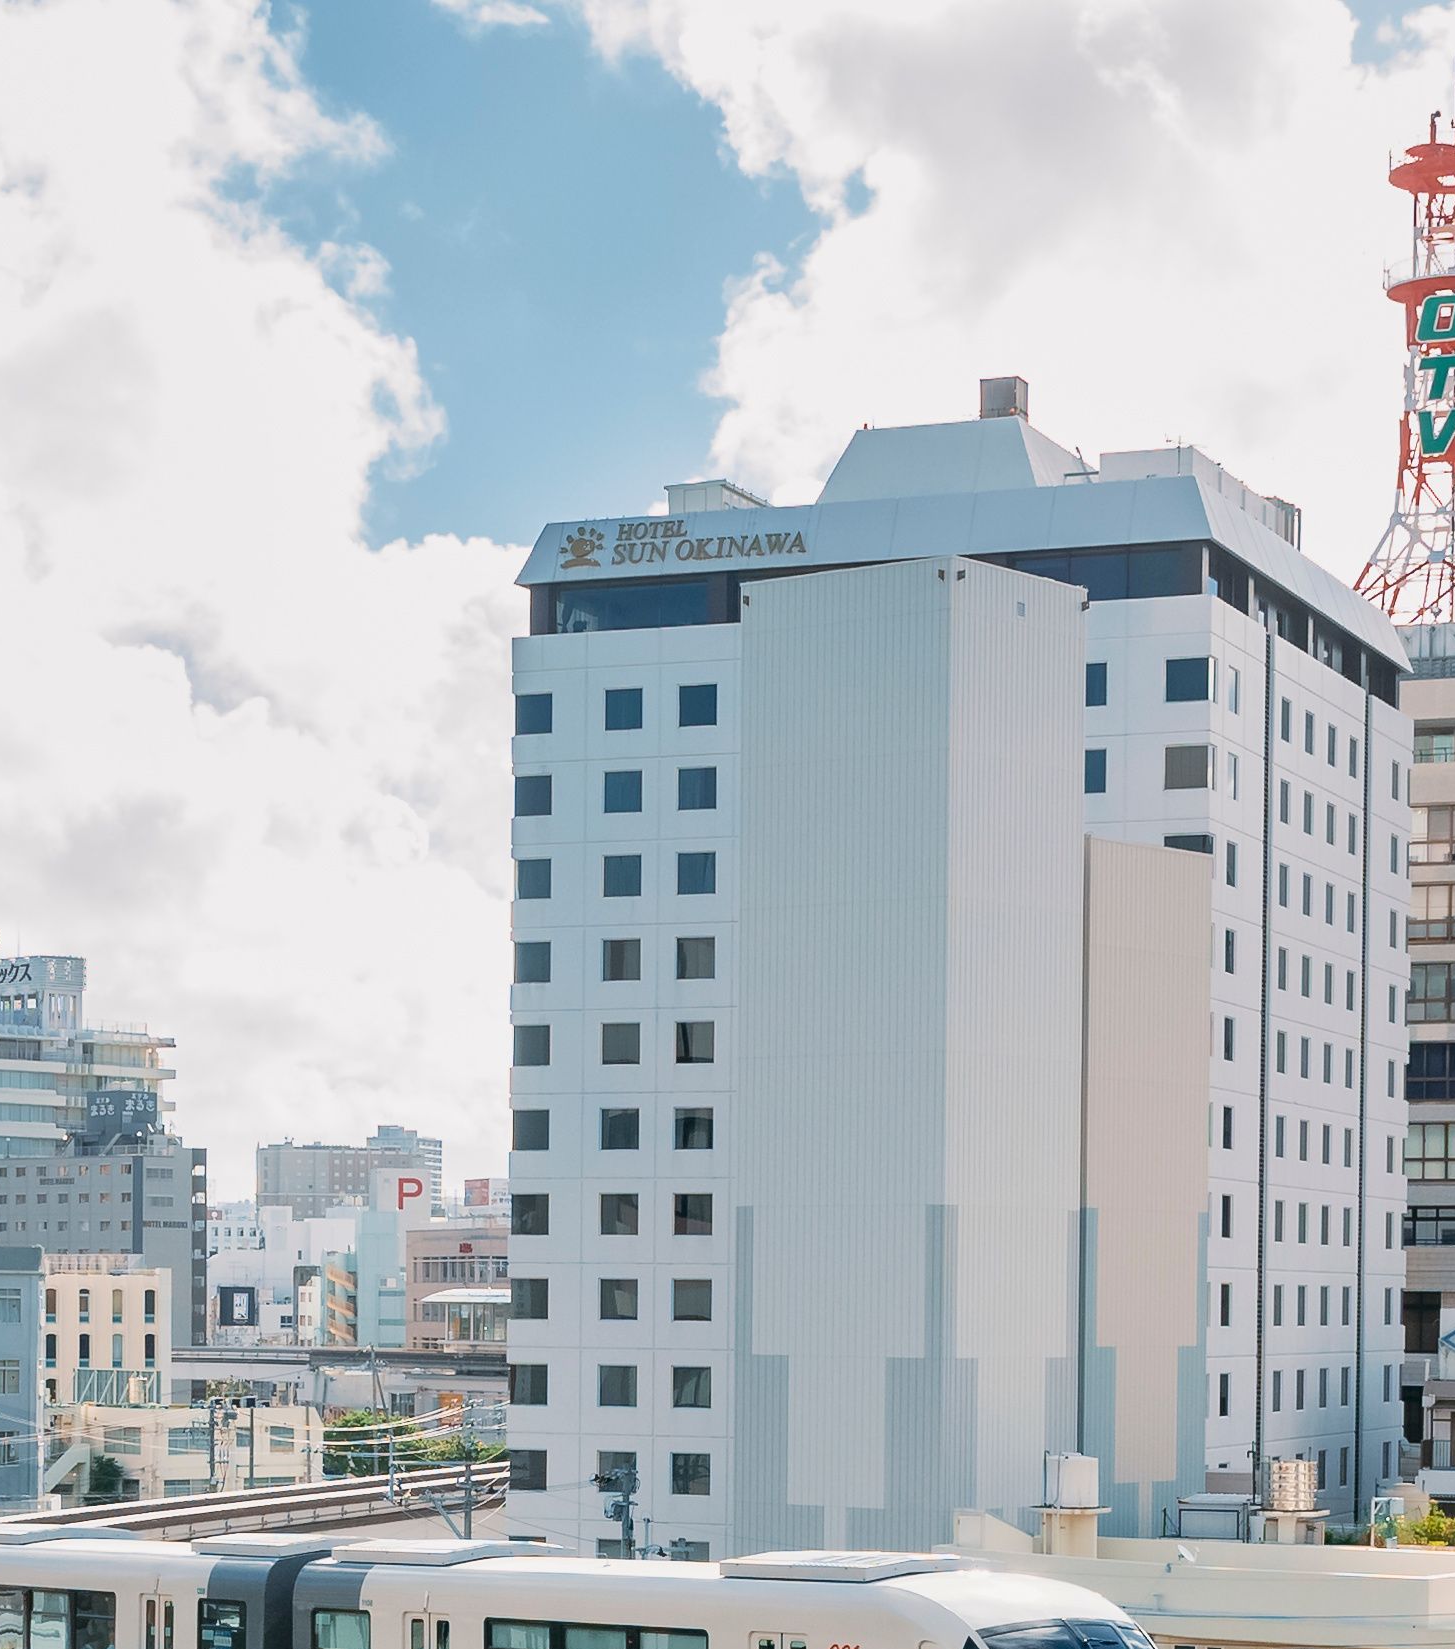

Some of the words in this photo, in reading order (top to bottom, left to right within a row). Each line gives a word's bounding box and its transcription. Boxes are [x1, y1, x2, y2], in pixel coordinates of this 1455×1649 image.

[616, 520, 688, 541] HOTEL
[611, 540, 670, 565] SUN
[674, 531, 808, 561] OKINAWA
[90, 1104, 115, 1117] まるき
[124, 1099, 156, 1113] まるき
[397, 1177, 423, 1210] P
